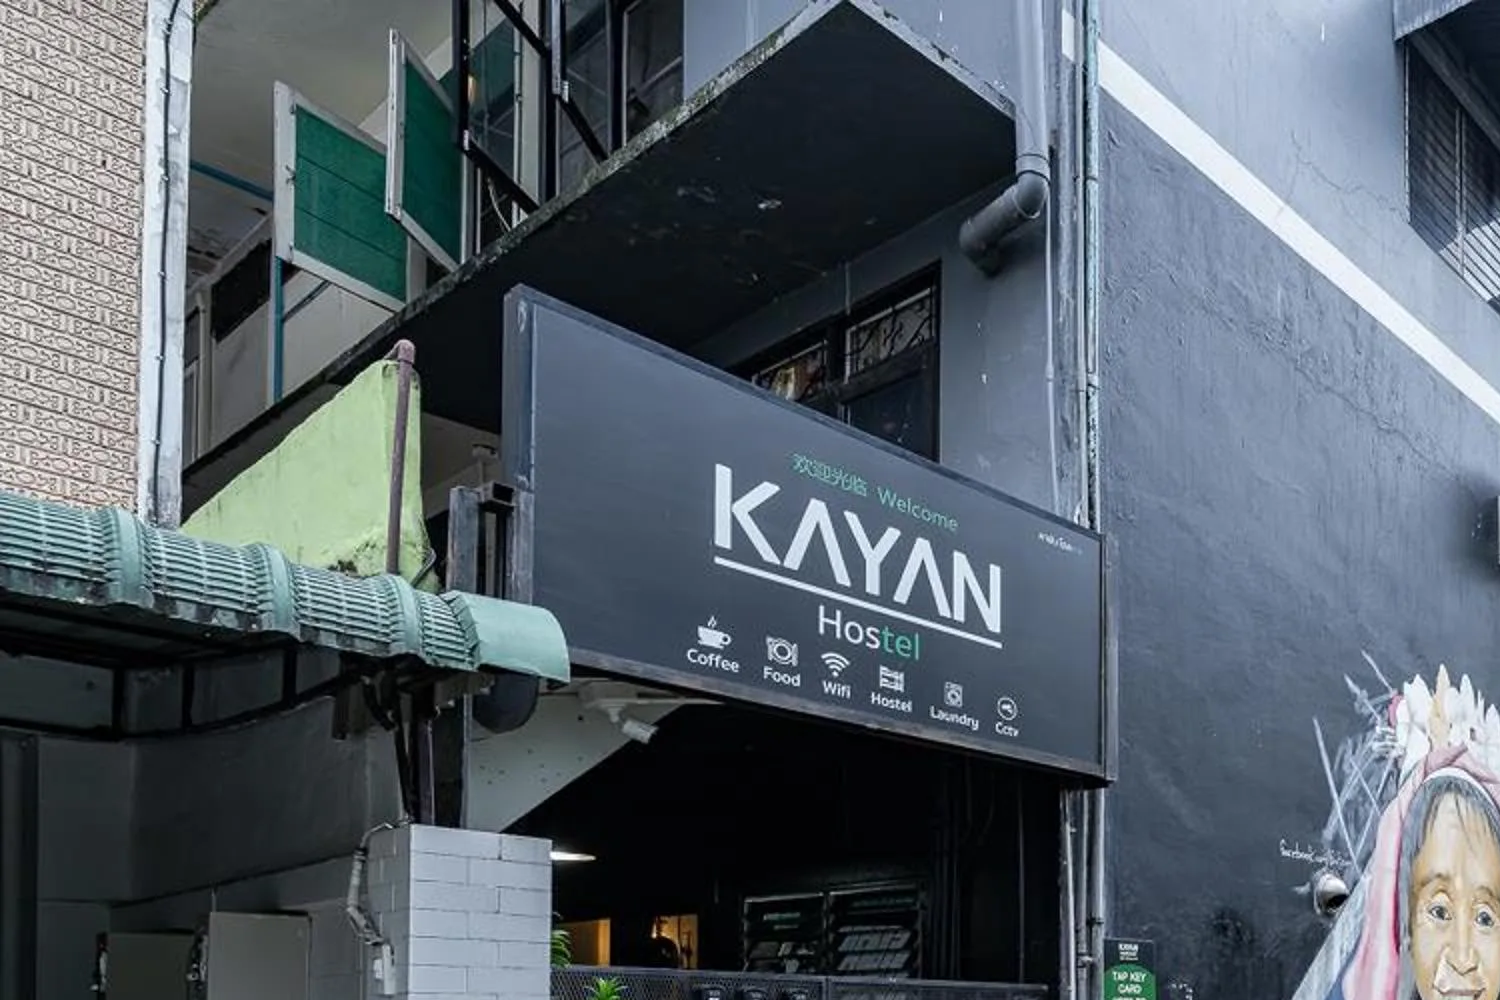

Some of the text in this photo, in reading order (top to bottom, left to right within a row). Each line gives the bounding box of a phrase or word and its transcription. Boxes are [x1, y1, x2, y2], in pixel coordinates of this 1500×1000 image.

[792, 453, 959, 532] 欢迎光临 Welcome
[714, 463, 1001, 633] KAYAN
[818, 604, 921, 660] Hostel
[686, 648, 741, 673] Coffee
[763, 665, 801, 687] Food
[821, 680, 852, 699] Wifi
[870, 692, 913, 713] Hostel
[929, 705, 980, 731] Laundry
[995, 722, 1020, 737] Cctv
[1112, 971, 1147, 982] TAP KEY
[1117, 983, 1143, 994] CARD
